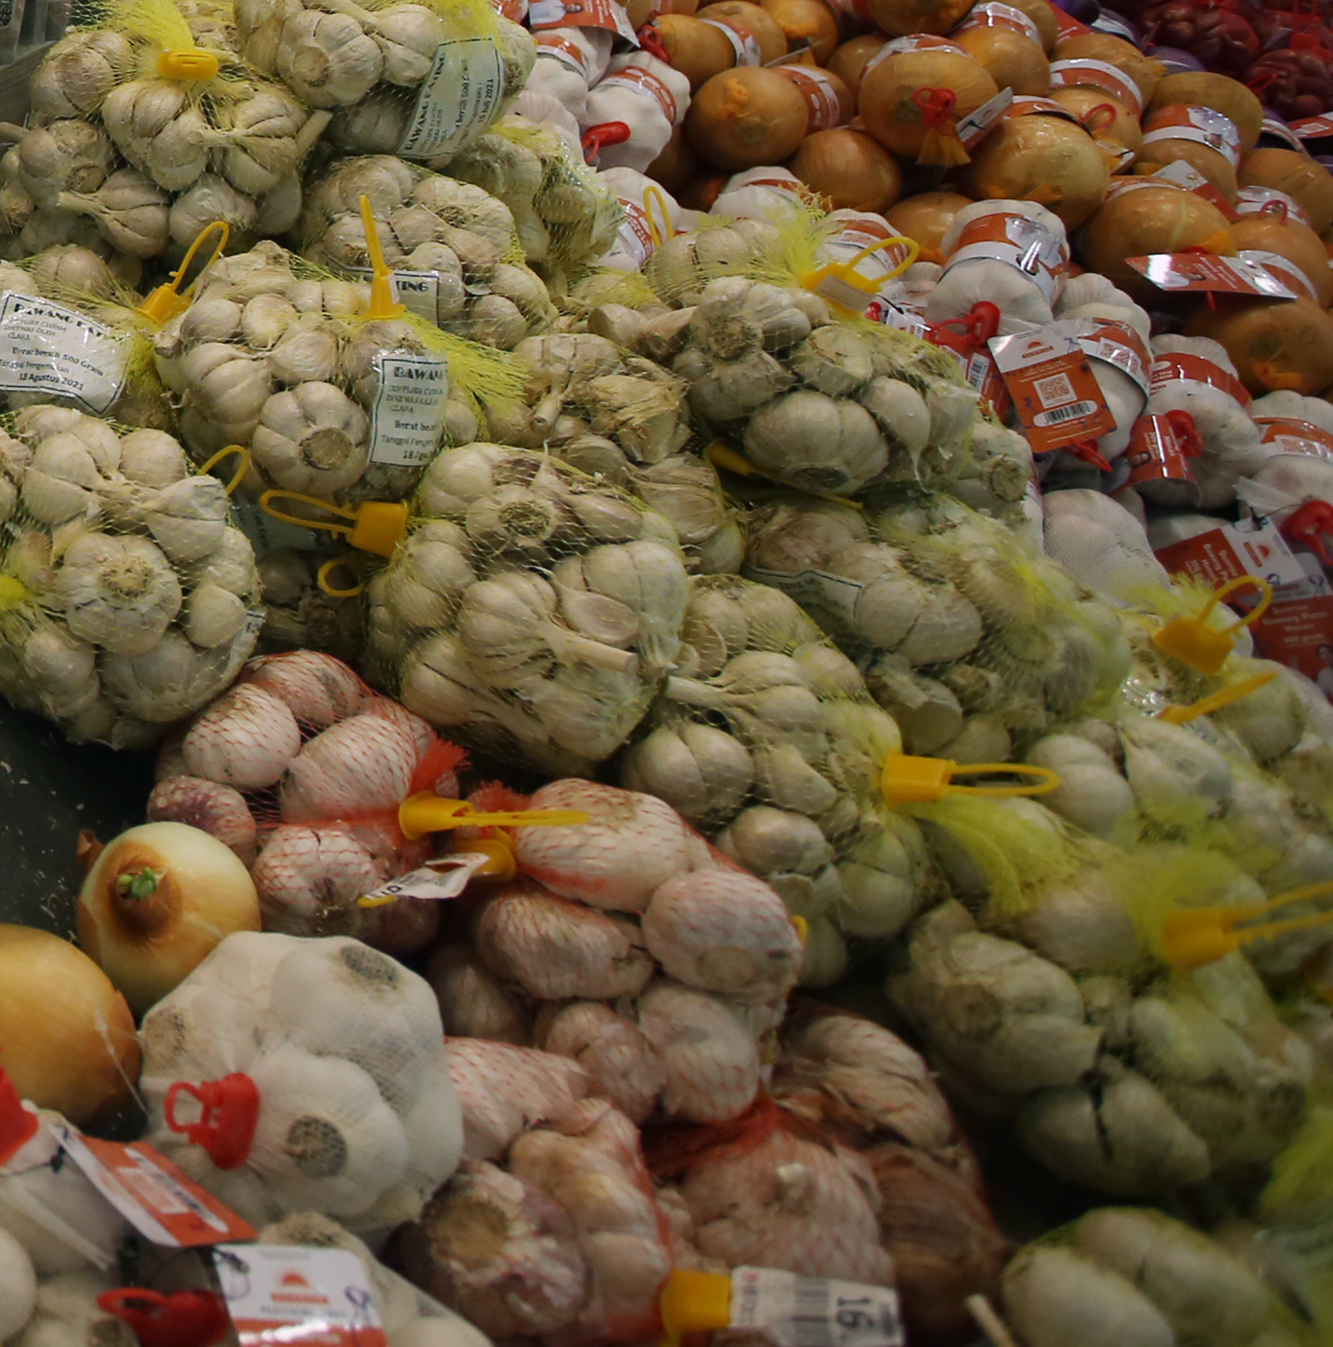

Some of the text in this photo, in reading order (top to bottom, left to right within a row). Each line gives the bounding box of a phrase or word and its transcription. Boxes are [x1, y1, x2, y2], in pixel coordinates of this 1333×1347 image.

[81, 360, 104, 376] Gram
[29, 373, 60, 383] Agustus
[61, 378, 84, 391] 2021
